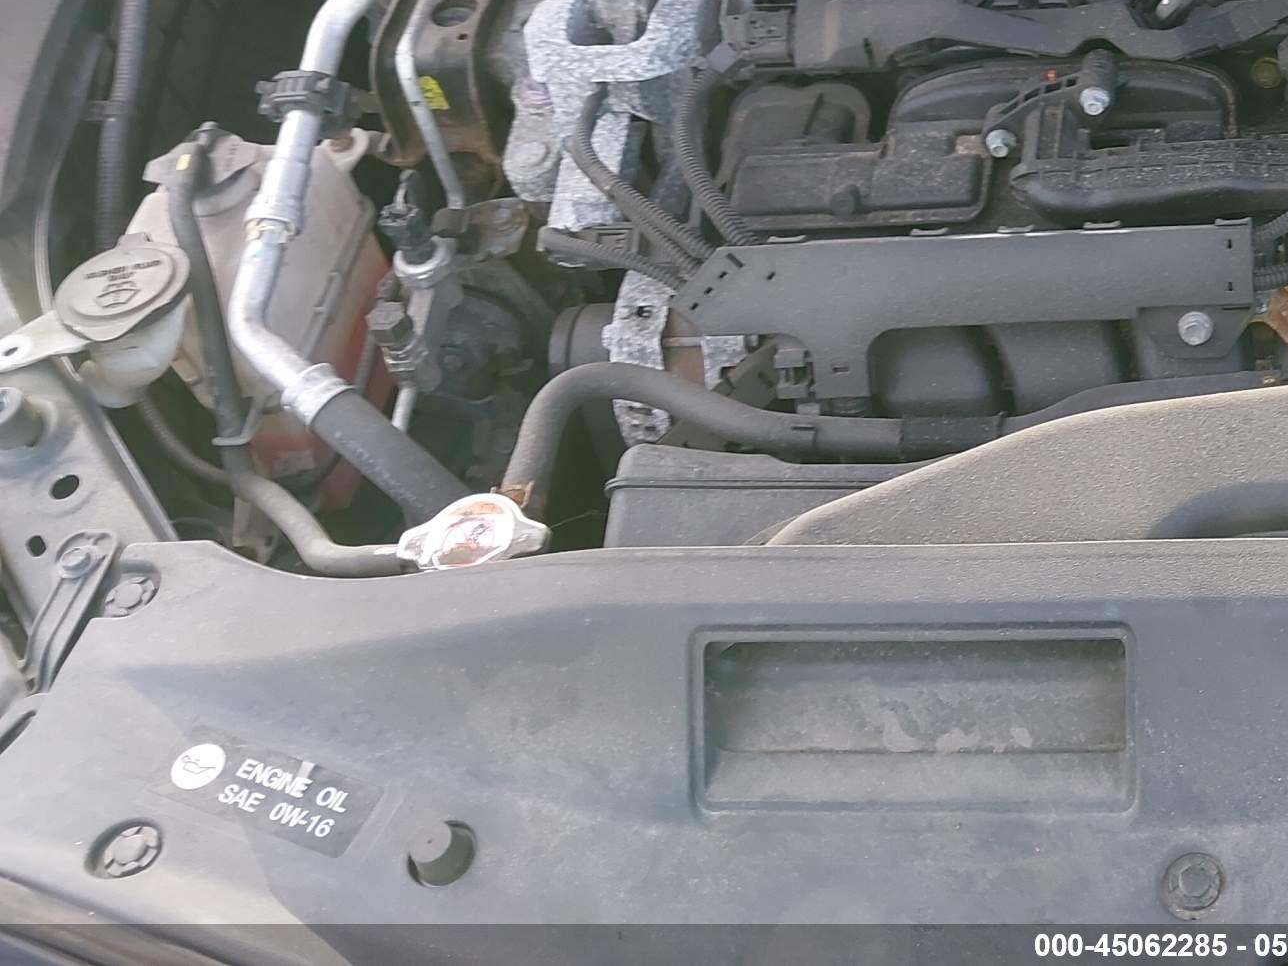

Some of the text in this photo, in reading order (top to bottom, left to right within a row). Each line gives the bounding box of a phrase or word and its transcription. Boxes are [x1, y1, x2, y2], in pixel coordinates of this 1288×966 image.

[218, 784, 335, 838] SAE 0W-16
[235, 758, 349, 813] ENGINE OIL
